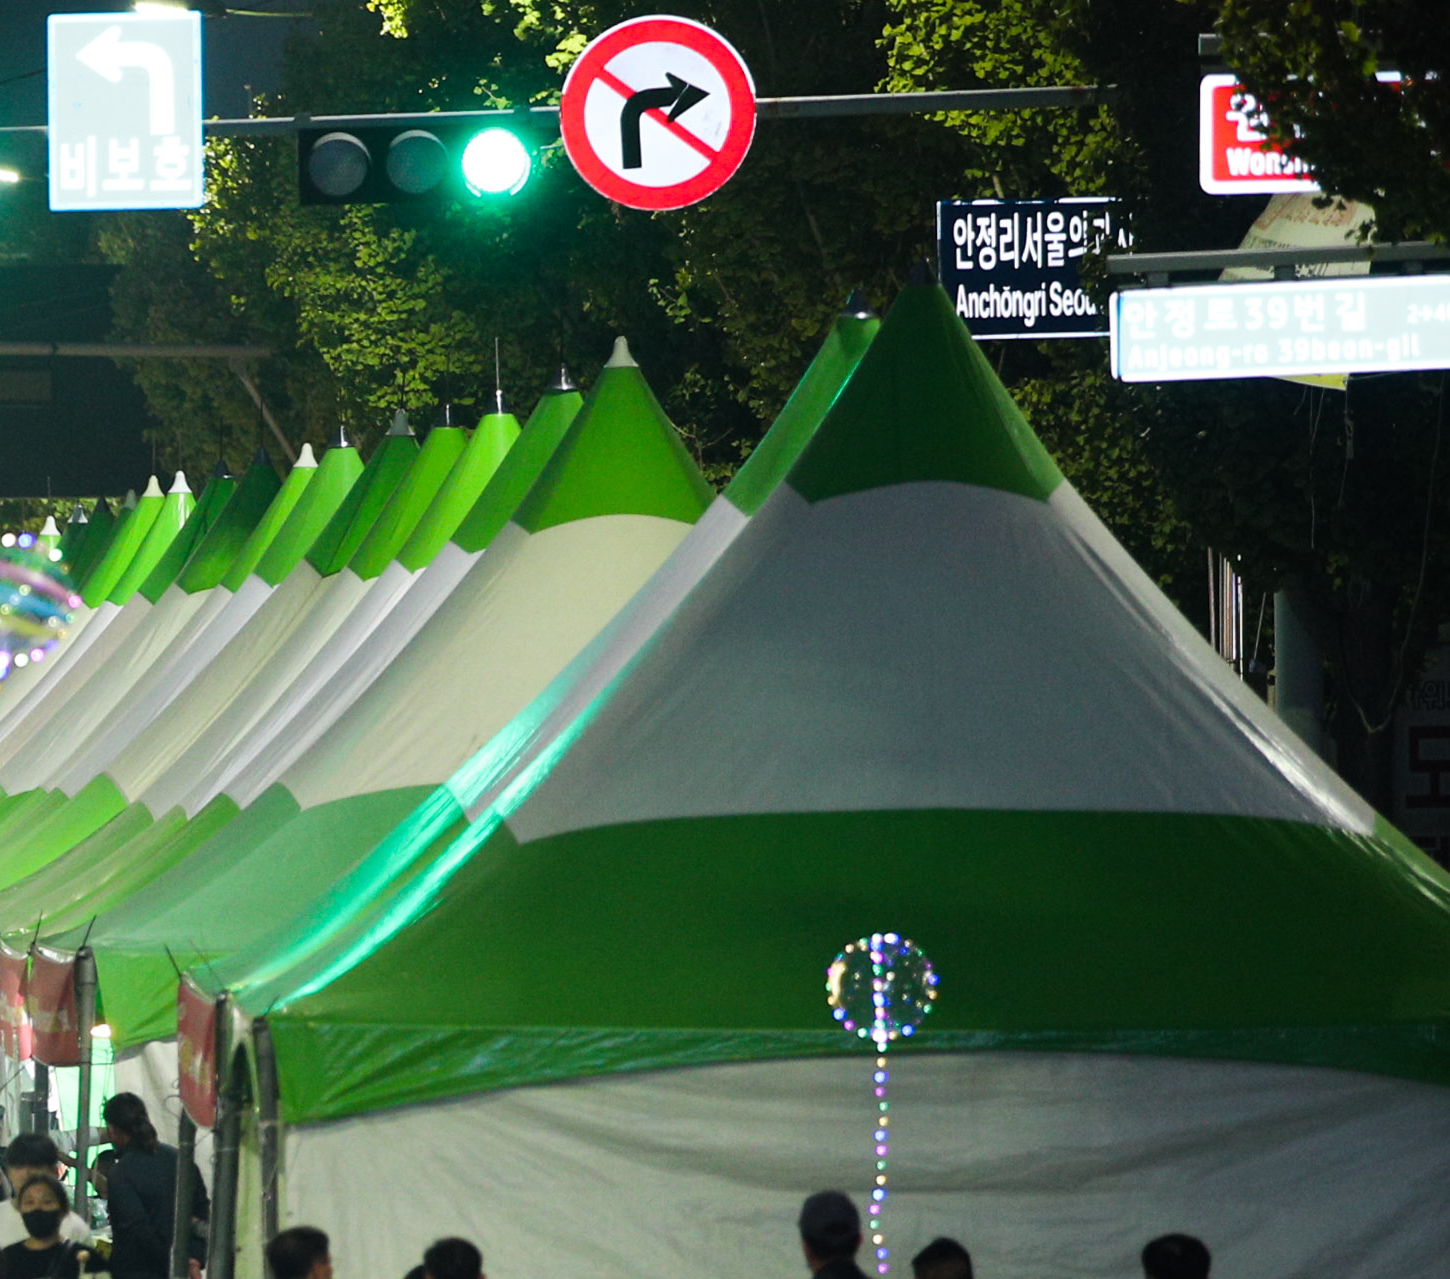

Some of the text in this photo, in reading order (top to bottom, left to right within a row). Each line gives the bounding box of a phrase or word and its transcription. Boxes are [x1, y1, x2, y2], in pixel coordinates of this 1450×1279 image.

[60, 135, 192, 198] 비보호
[1049, 280, 1103, 317] Seou
[1128, 333, 1420, 370] Anjeong-ro 39beon-gil
